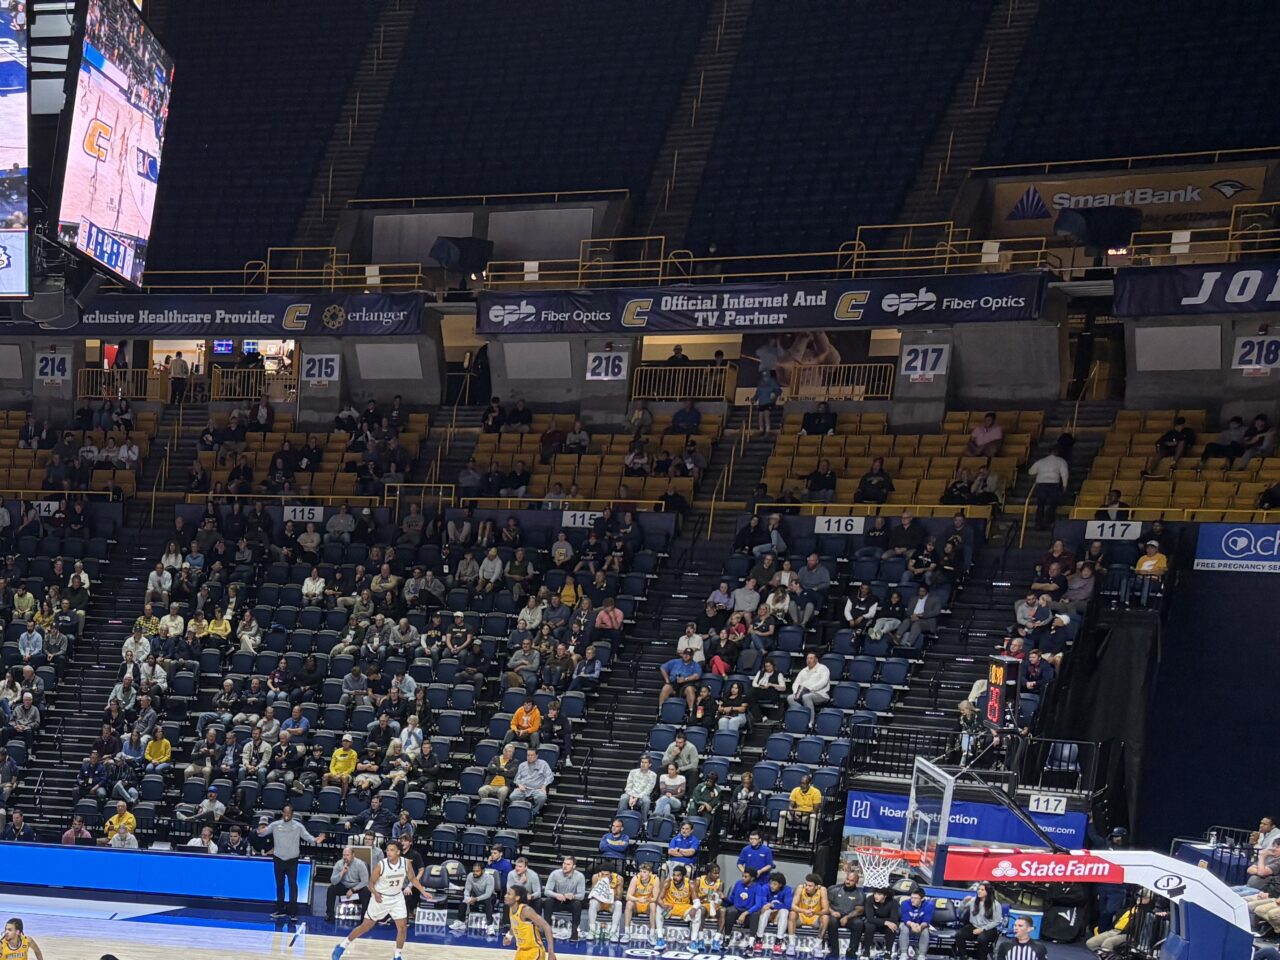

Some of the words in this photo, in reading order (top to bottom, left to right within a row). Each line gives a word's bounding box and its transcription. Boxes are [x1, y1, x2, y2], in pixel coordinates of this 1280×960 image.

[1052, 186, 1202, 209] SmartBank
[661, 294, 720, 311] Official
[722, 292, 788, 309] Internet
[793, 290, 827, 306] And
[942, 297, 977, 310] Fiber
[980, 294, 1025, 309] Optics
[139, 310, 211, 324] Healthcare
[216, 310, 275, 324] Provider
[347, 308, 408, 327] erlanger
[541, 310, 569, 322] Fiber
[572, 309, 611, 323] Optics
[694, 312, 720, 327] TV
[724, 310, 787, 326] Partner
[904, 347, 945, 372] 217
[1240, 339, 1280, 365] 218
[39, 357, 67, 377] 214
[305, 357, 335, 378] 215
[590, 355, 623, 377] 216
[291, 508, 315, 521] 115
[570, 514, 598, 527] 115
[824, 518, 854, 532] 116
[1096, 523, 1131, 538] 117
[1217, 562, 1266, 571] PREGNANCY
[1033, 797, 1063, 812] 117
